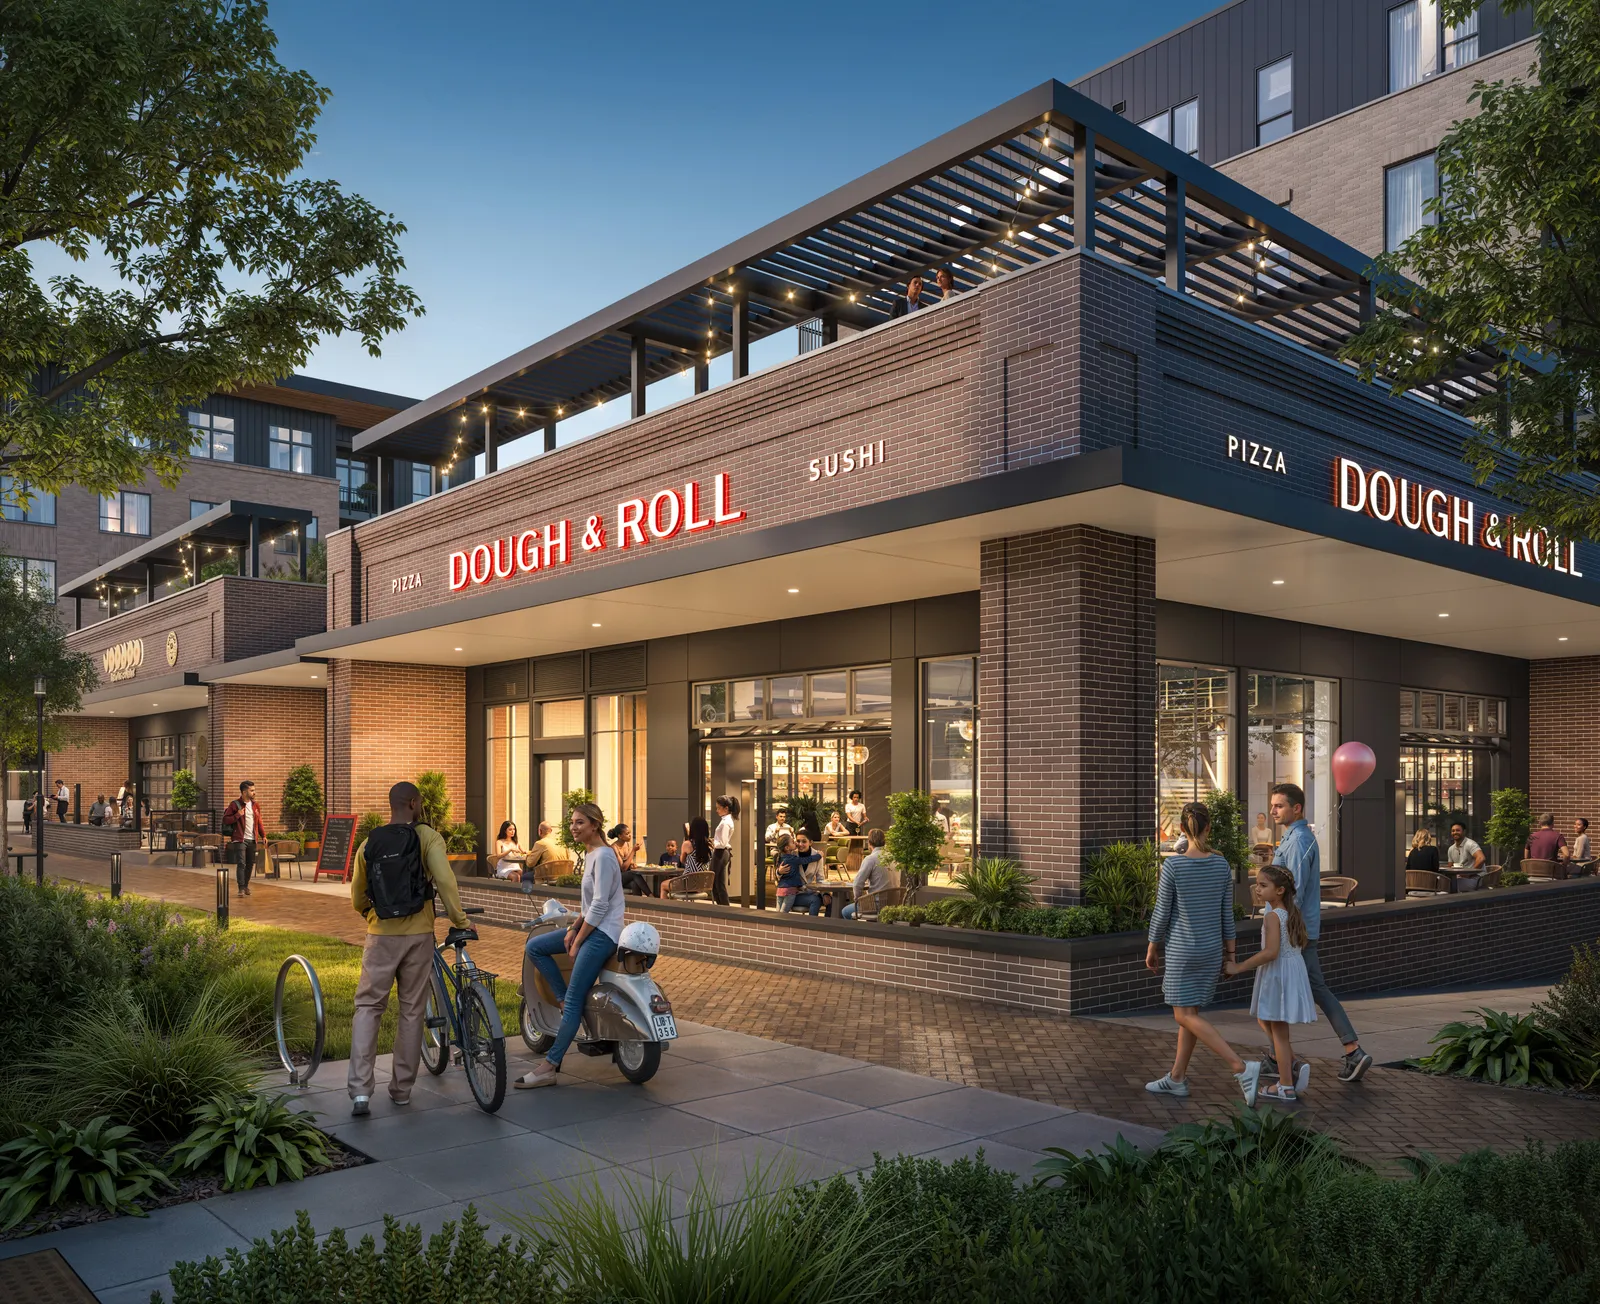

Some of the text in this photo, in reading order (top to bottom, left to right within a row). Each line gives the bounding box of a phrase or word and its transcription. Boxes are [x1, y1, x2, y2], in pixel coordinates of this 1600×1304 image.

[809, 439, 887, 482] SUSHI
[1228, 434, 1287, 475] PIZZA
[1335, 456, 1474, 547] DOUGH
[1483, 512, 1503, 550] &
[448, 471, 747, 591] DOUGH & ROLL
[392, 572, 423, 594] PIZZA
[658, 1026, 675, 1038] 358
